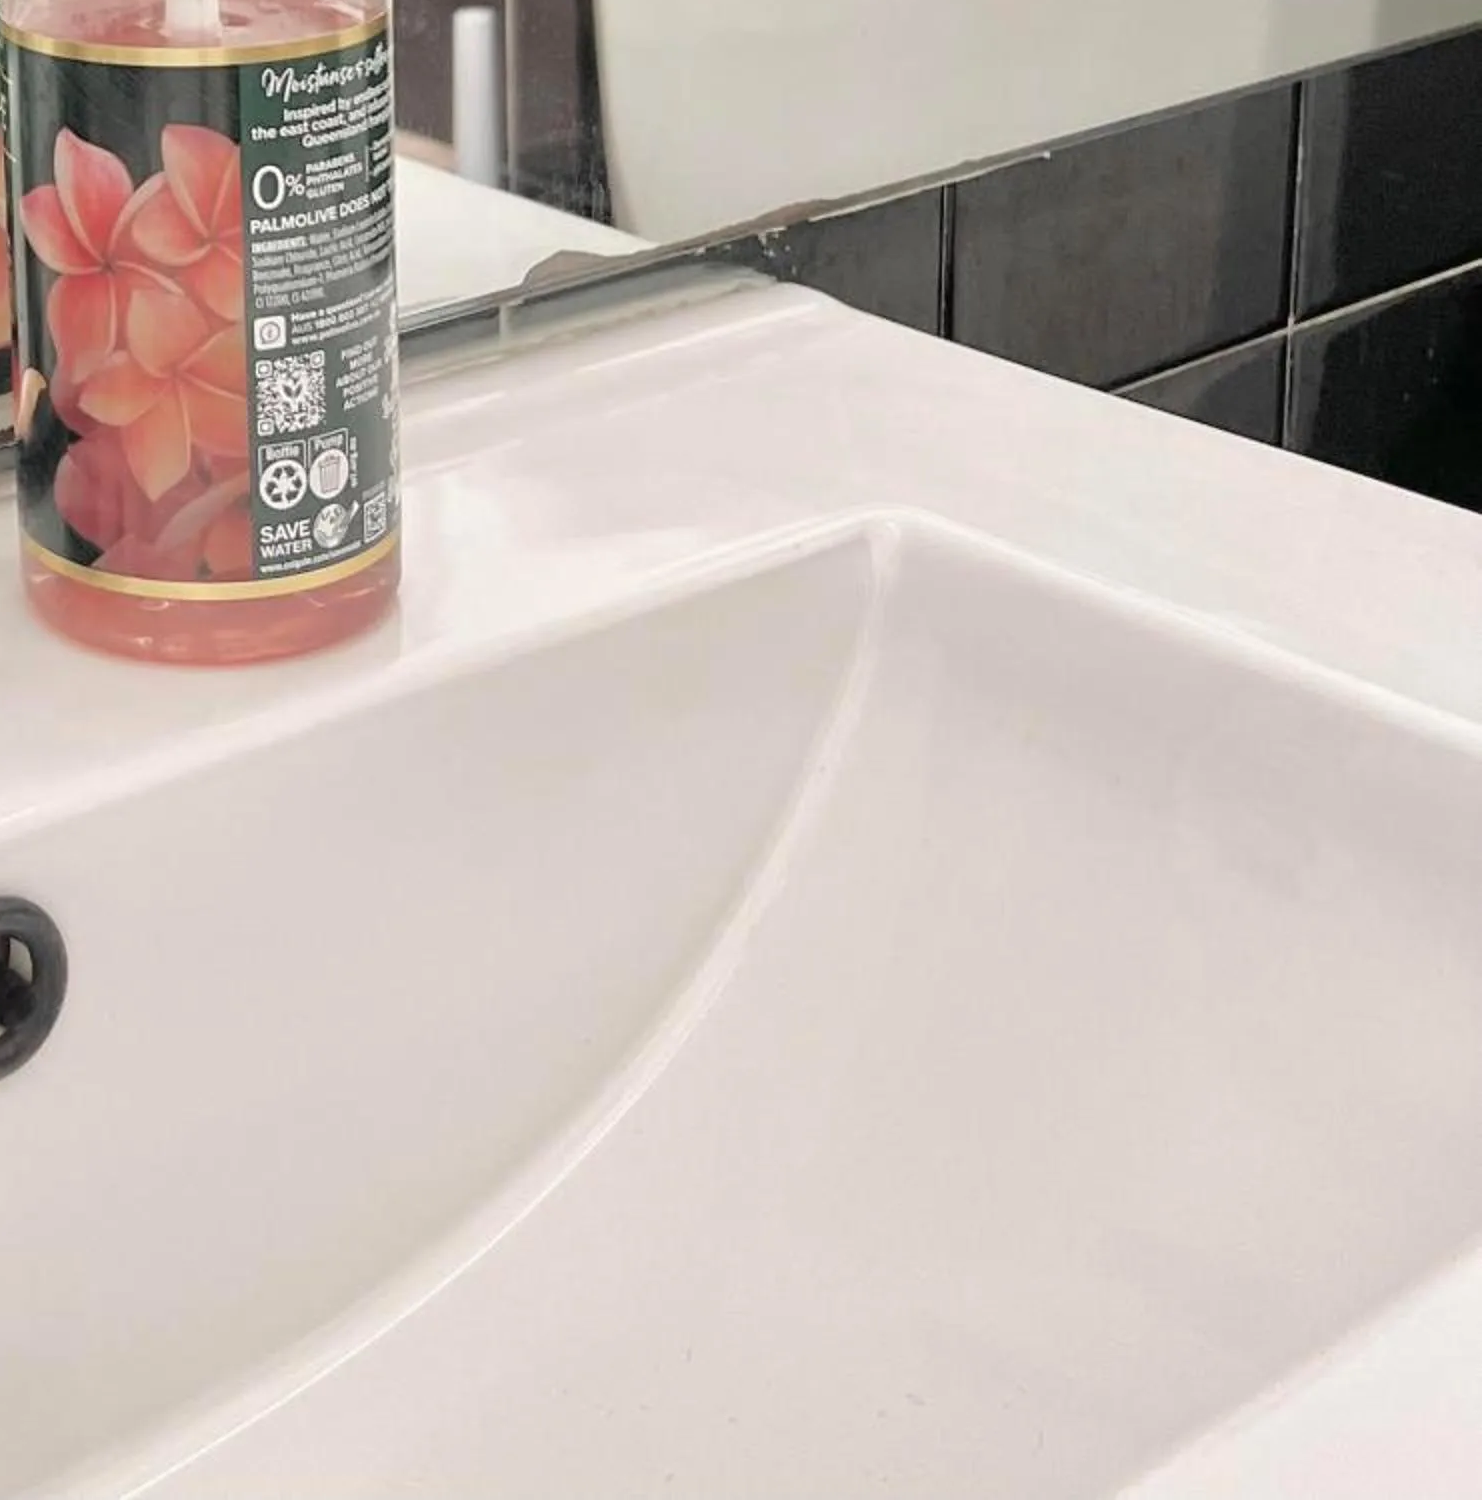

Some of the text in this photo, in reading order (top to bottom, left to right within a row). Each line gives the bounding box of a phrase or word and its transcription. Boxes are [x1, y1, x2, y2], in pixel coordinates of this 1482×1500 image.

[251, 126, 277, 141] the
[279, 121, 309, 137] east
[250, 206, 338, 235] PALMOLIVE
[339, 194, 370, 218] DOES
[260, 518, 311, 543] SAVE
[260, 539, 314, 559] WATER
